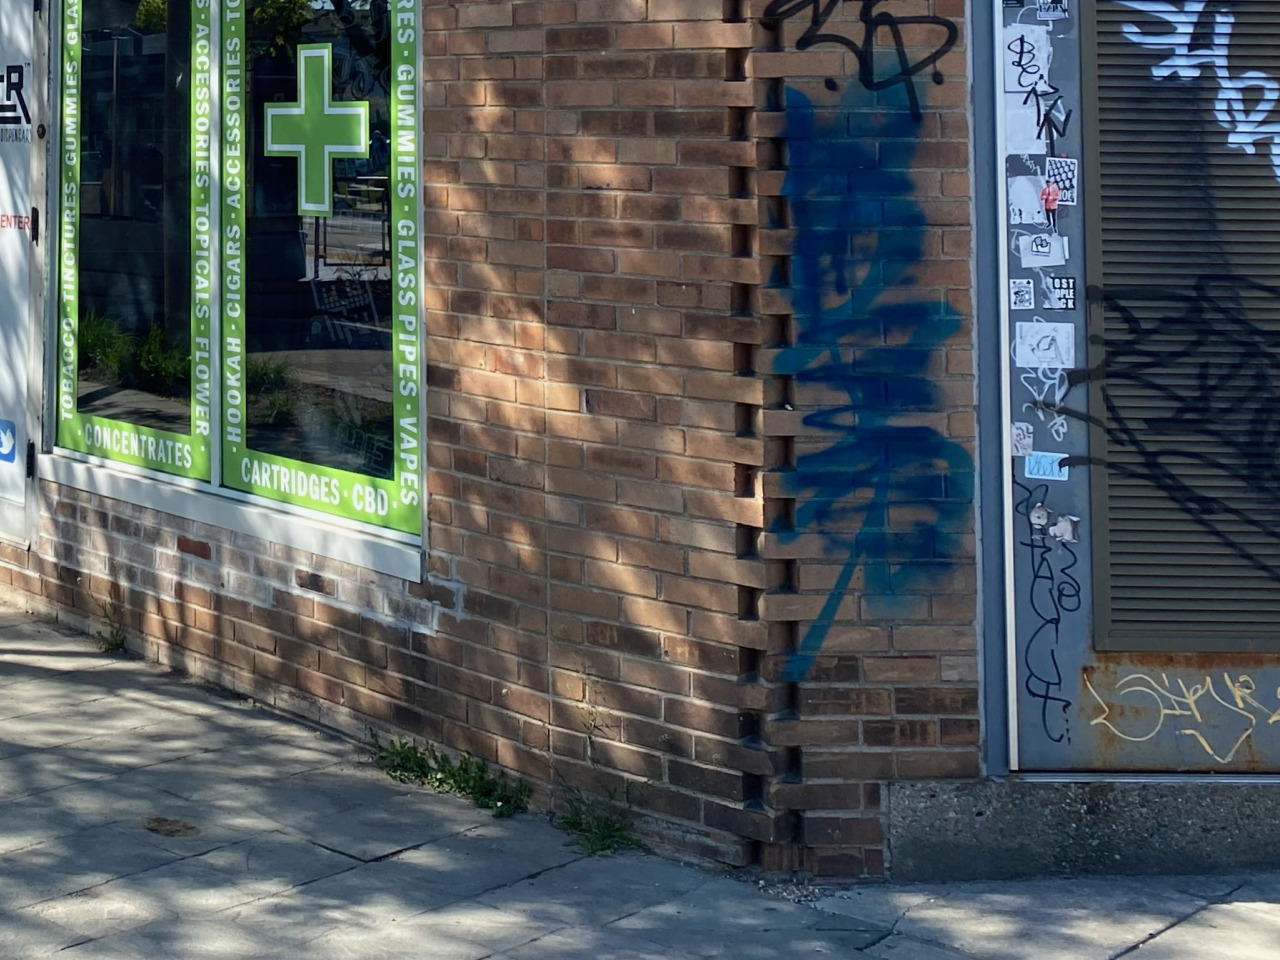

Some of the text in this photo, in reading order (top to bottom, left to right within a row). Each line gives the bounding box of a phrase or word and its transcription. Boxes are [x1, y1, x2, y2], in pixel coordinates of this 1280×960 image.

[65, 60, 78, 166] GUMMIES
[195, 24, 210, 188] ACCESSORIES
[226, 37, 241, 210] ACCESSORIES
[396, 64, 416, 199] GUMMIES
[0, 214, 31, 231] ENTER
[63, 182, 76, 302] TINCTURES
[195, 204, 210, 318] TOPICALS
[226, 225, 241, 318] CIGARS
[397, 219, 416, 308] GLASS
[61, 317, 75, 421] TOBACCO
[195, 337, 210, 436] FLOWER
[226, 337, 242, 443] HOOKAH
[398, 314, 417, 397] PIPES
[84, 423, 192, 469] CONCENTRATES
[241, 457, 389, 516] CARTRIDGES CBD
[399, 416, 419, 506] VAPES
